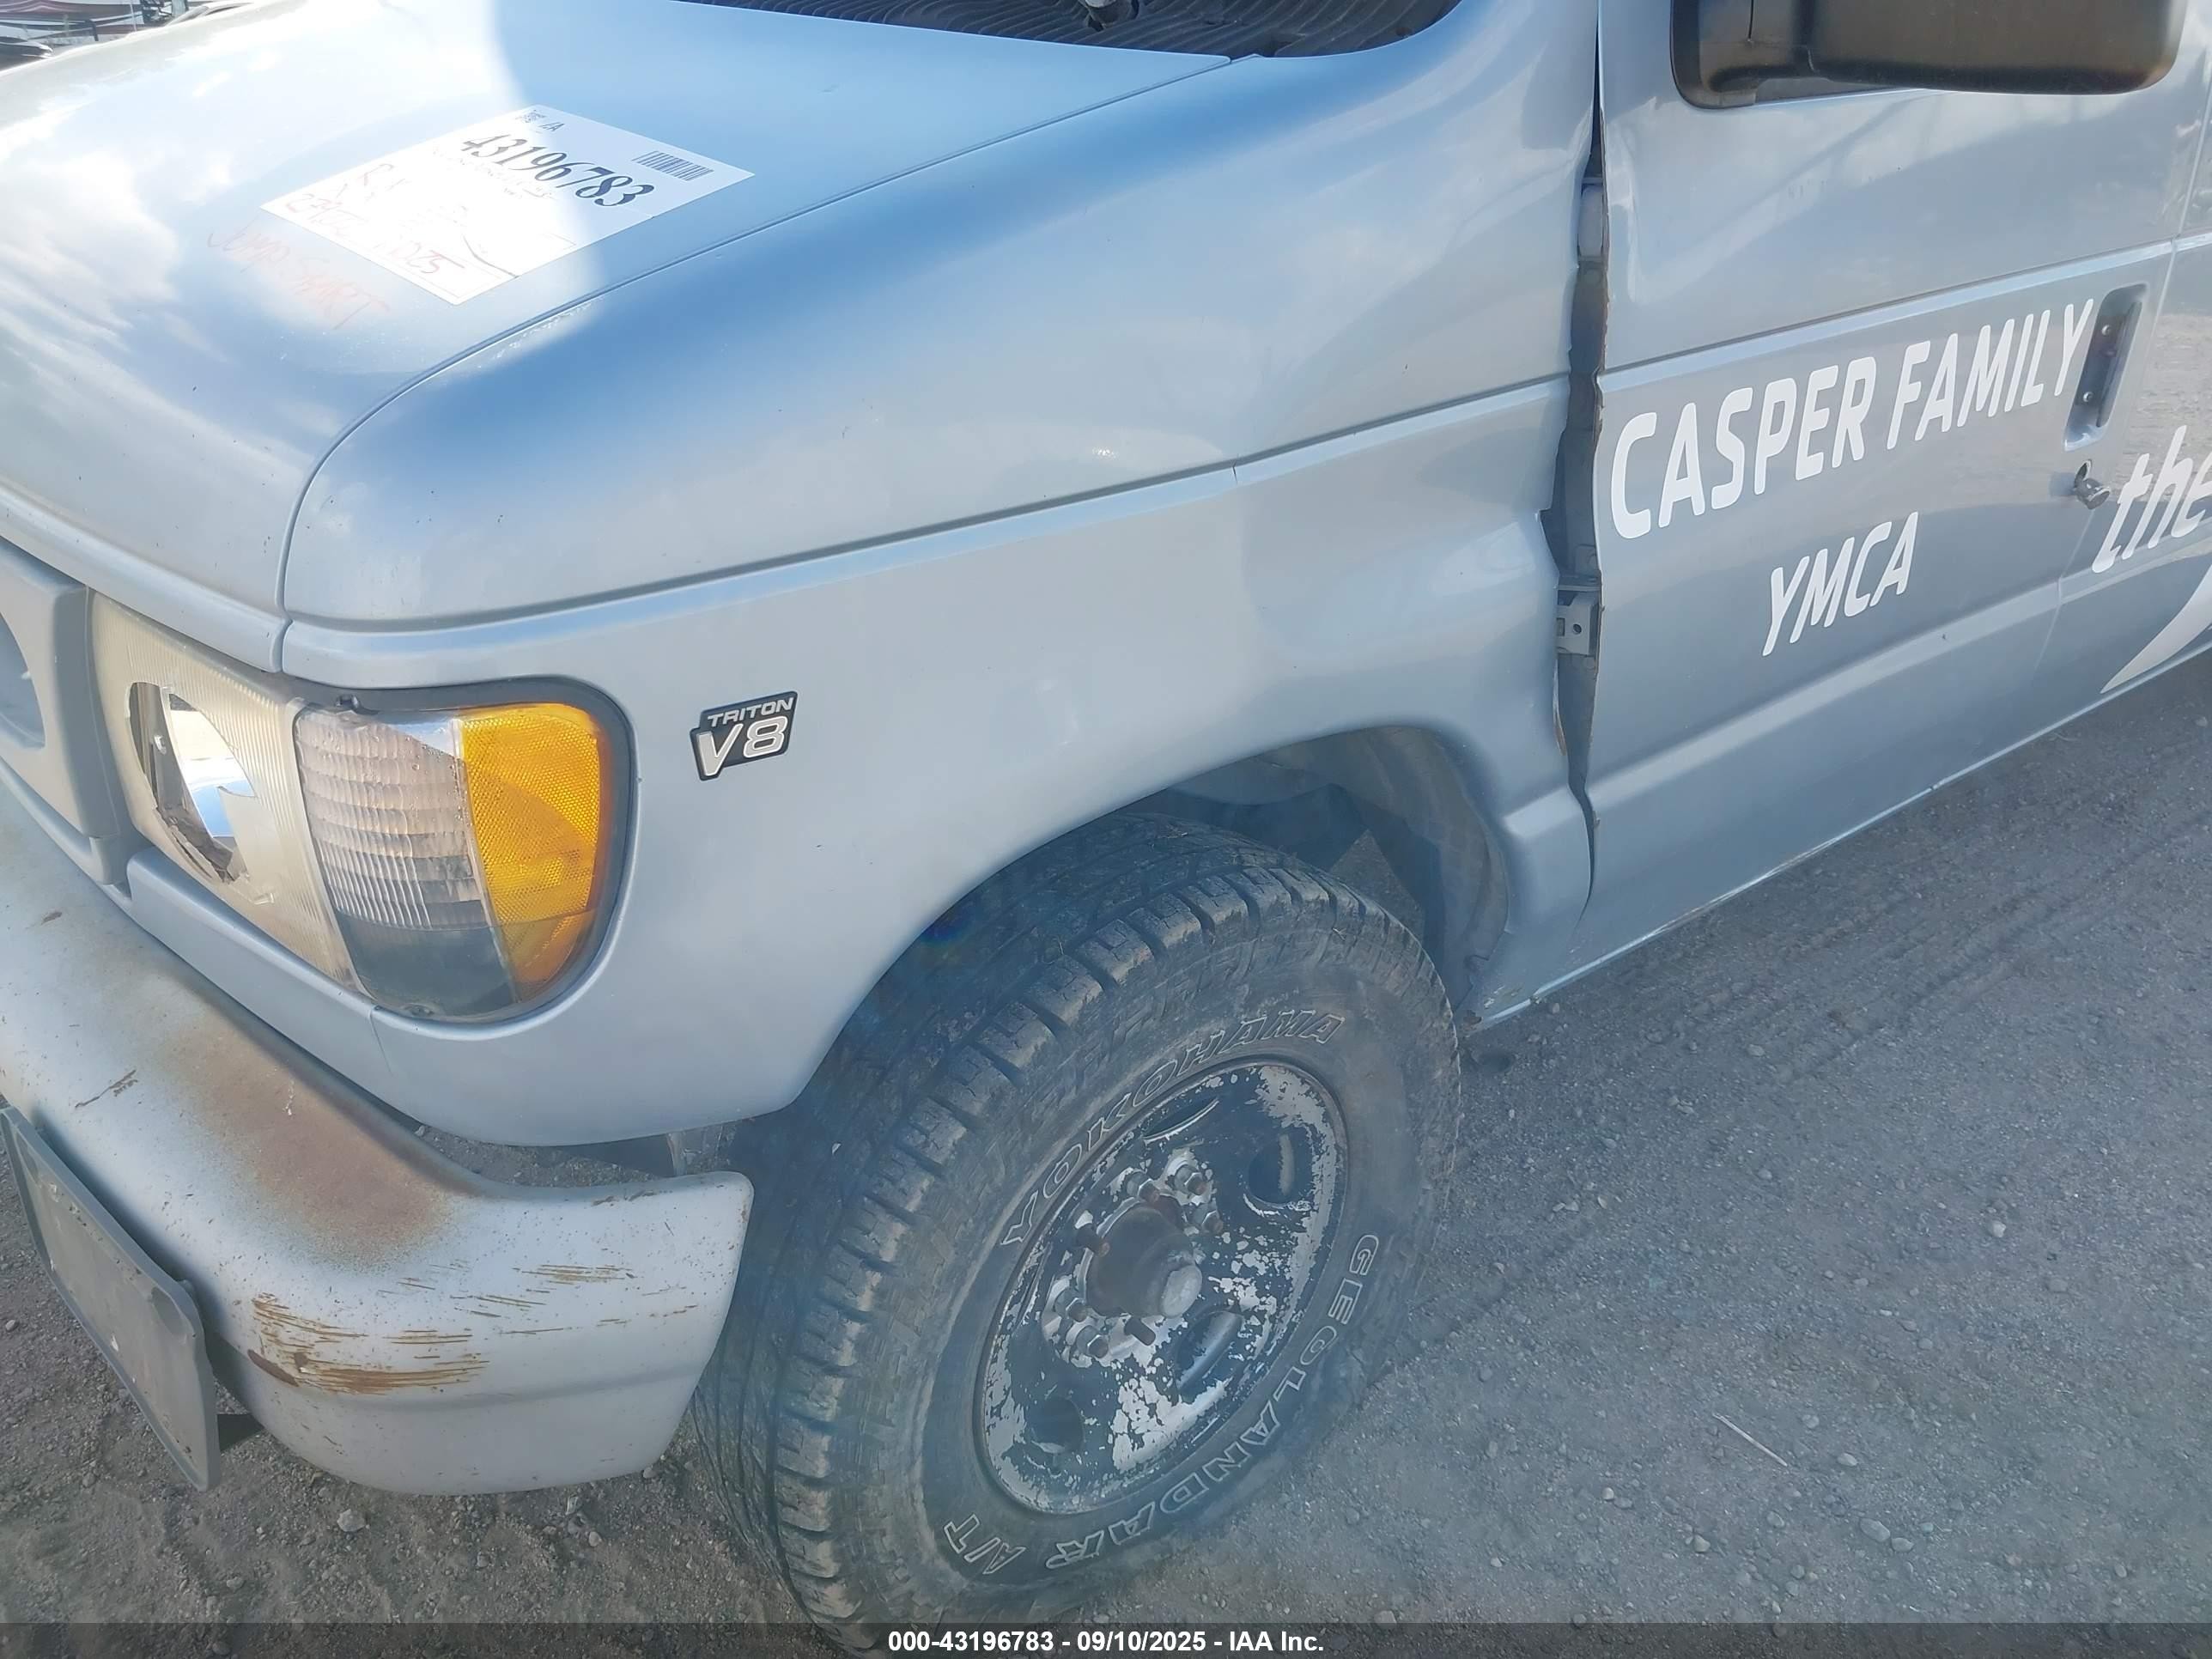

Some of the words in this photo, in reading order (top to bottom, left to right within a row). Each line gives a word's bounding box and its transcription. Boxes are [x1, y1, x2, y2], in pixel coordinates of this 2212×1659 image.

[461, 135, 654, 207] 43196783
[1611, 356, 1876, 539] CASPER
[1886, 299, 2094, 451] FAMILY
[2092, 424, 2212, 574] the
[1762, 512, 1919, 657] YMCA
[696, 715, 788, 776] V8
[707, 696, 794, 728] TRITON
[1000, 1008, 1346, 1246] YOKOHAMA
[1044, 1234, 1380, 1570] GEOLANDAR
[944, 1513, 1027, 1575] A/T
